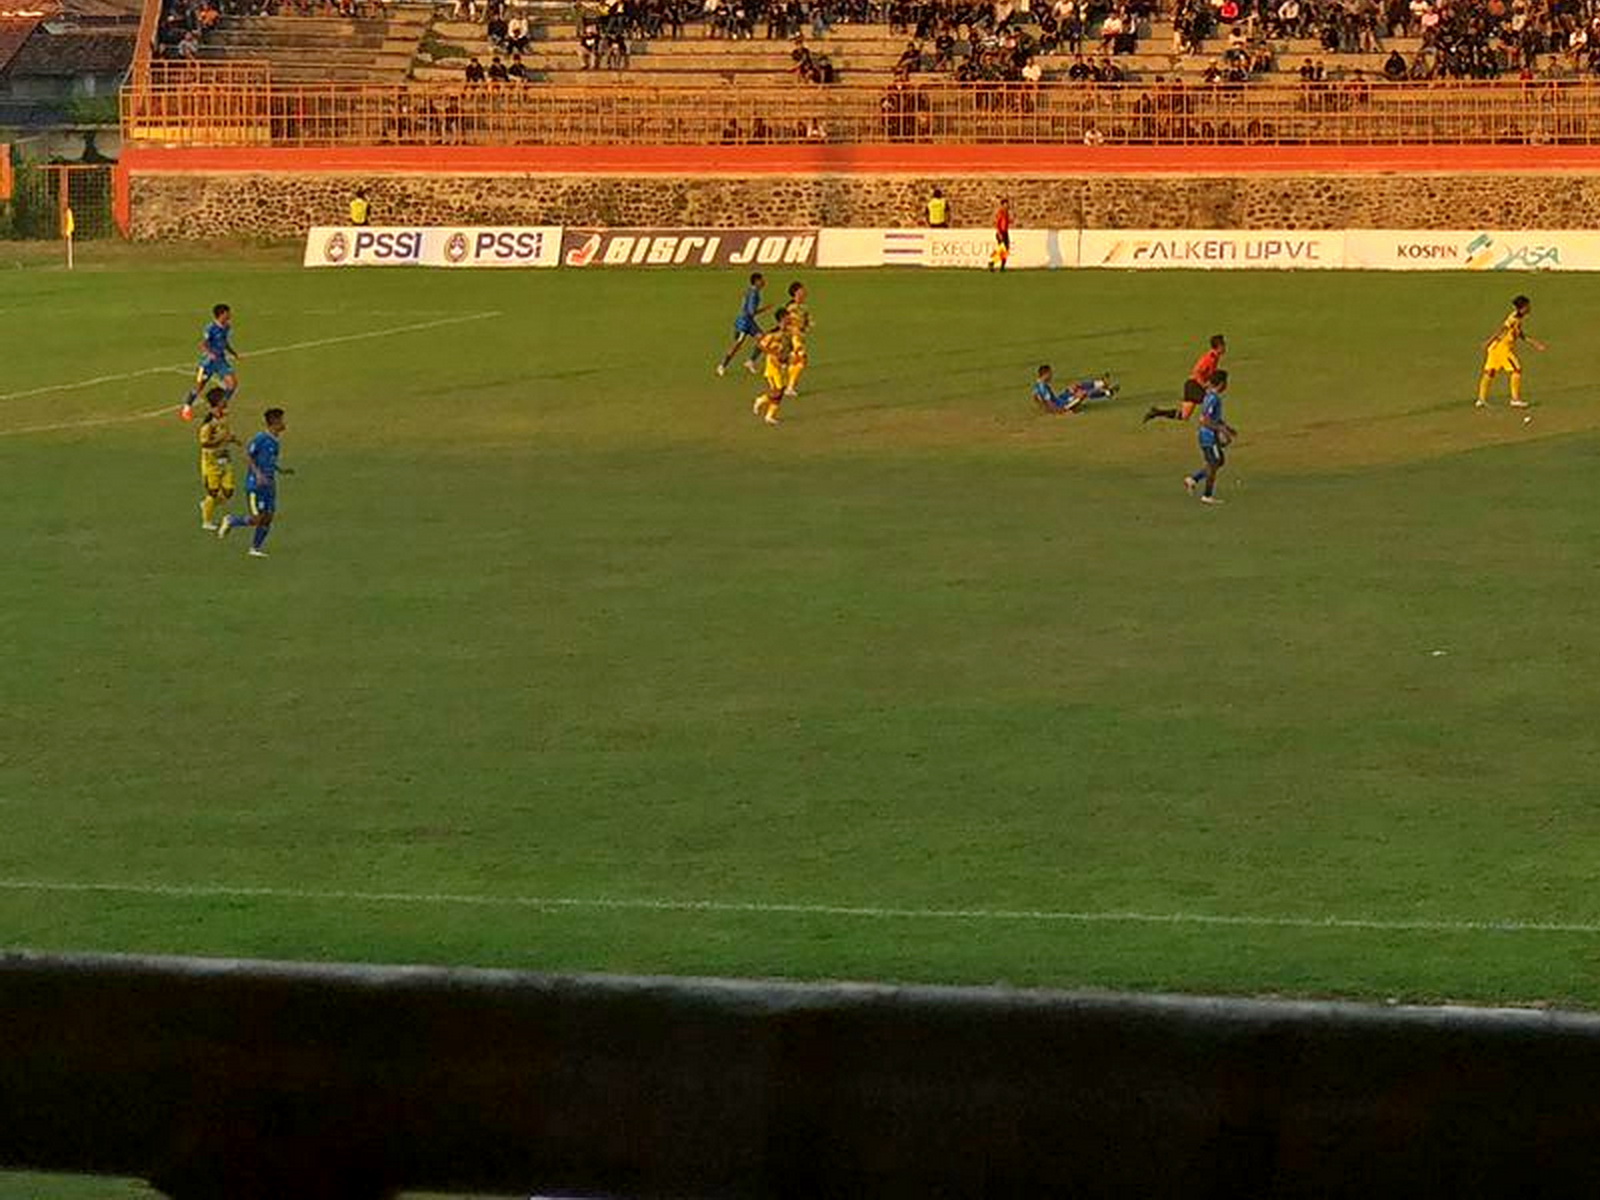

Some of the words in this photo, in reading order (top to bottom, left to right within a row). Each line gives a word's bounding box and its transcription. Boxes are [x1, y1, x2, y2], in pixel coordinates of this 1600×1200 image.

[354, 232, 422, 259] PSSI
[474, 232, 543, 259] PSSI
[1397, 244, 1458, 259] KOSPIN
